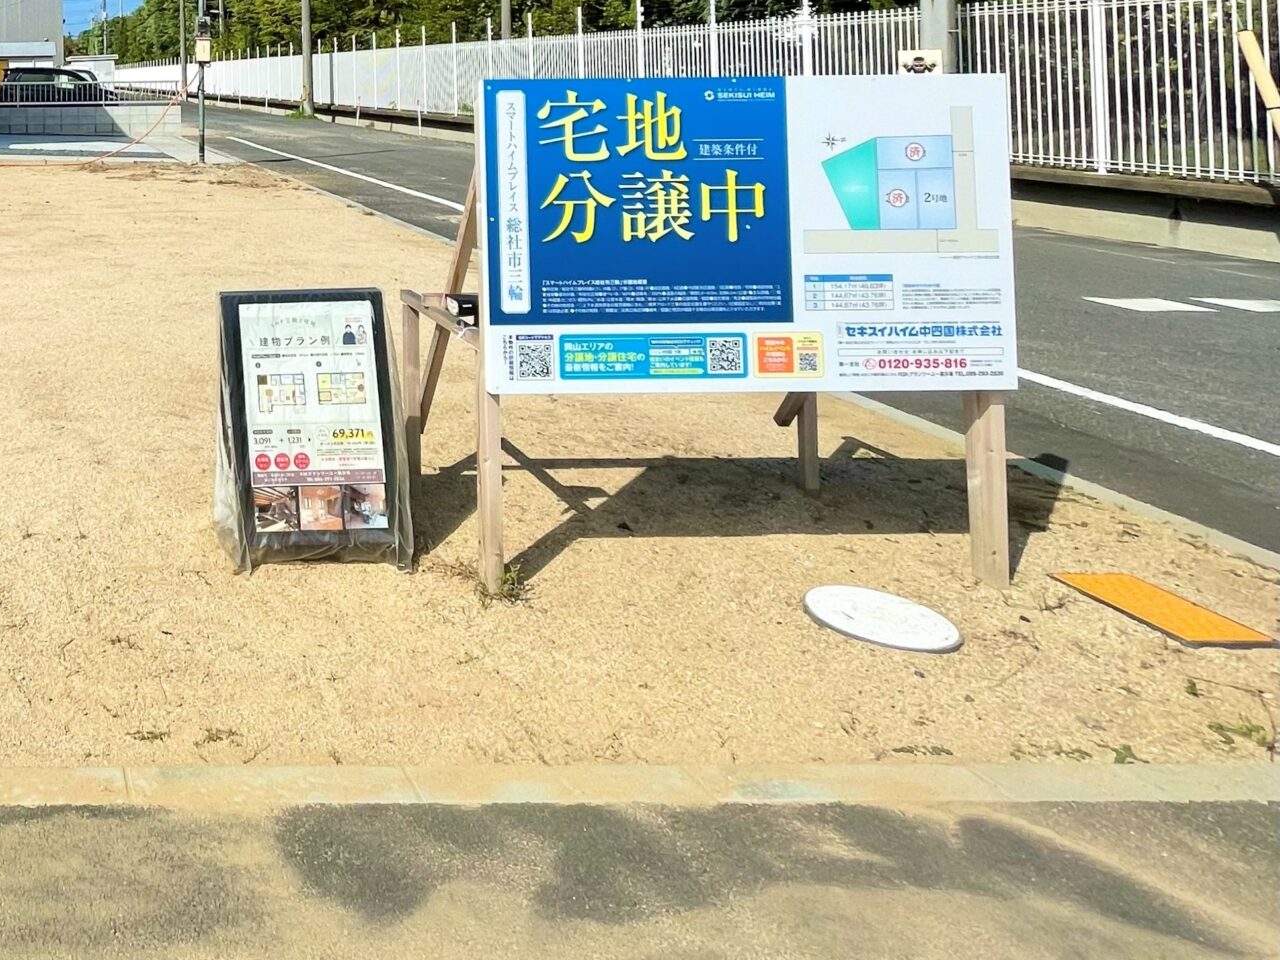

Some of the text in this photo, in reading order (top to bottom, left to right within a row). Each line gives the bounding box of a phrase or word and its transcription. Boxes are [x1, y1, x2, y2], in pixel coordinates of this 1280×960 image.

[717, 91, 752, 99] SEKISUI
[536, 90, 688, 162] 宅地
[698, 142, 759, 157] 建築条件付
[505, 101, 524, 302] スマートハイムプレイス 総社市三輪
[923, 192, 948, 204] 2号地
[539, 169, 766, 244] 分譲中
[845, 325, 1003, 338] セキスイハイム中四国株式会社
[259, 335, 331, 347] 建物プラン例
